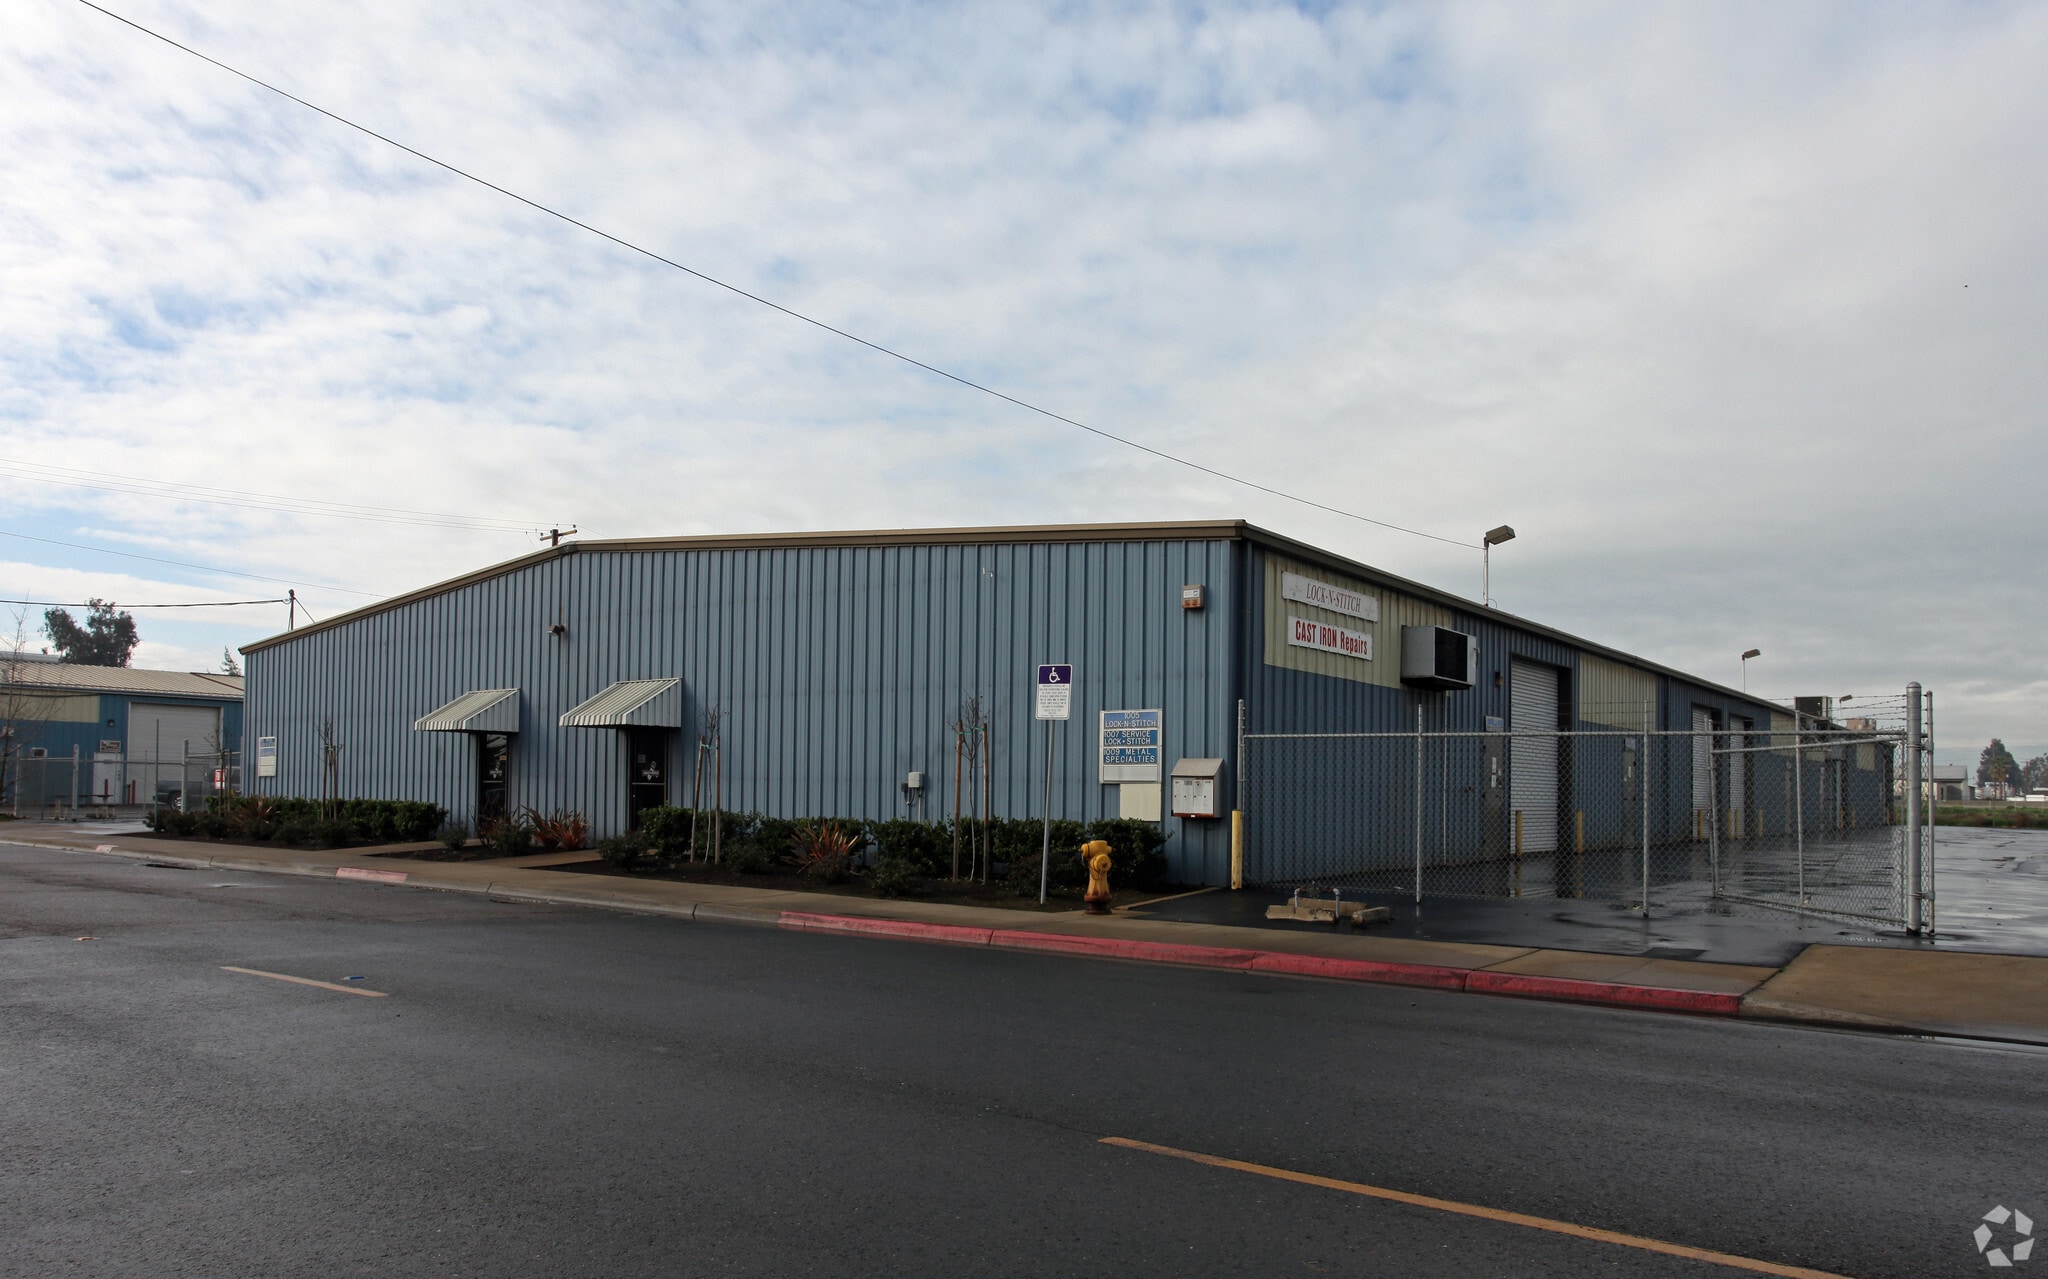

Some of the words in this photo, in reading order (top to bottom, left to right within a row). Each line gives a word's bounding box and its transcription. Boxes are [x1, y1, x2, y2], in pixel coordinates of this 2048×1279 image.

[1296, 620, 1317, 643] CAST
[1320, 625, 1337, 648] IRON
[1340, 630, 1367, 655] Repairs
[1104, 730, 1120, 738] 1007
[1121, 730, 1151, 738] SERVICE
[1105, 755, 1155, 763] SPECIALTIES
